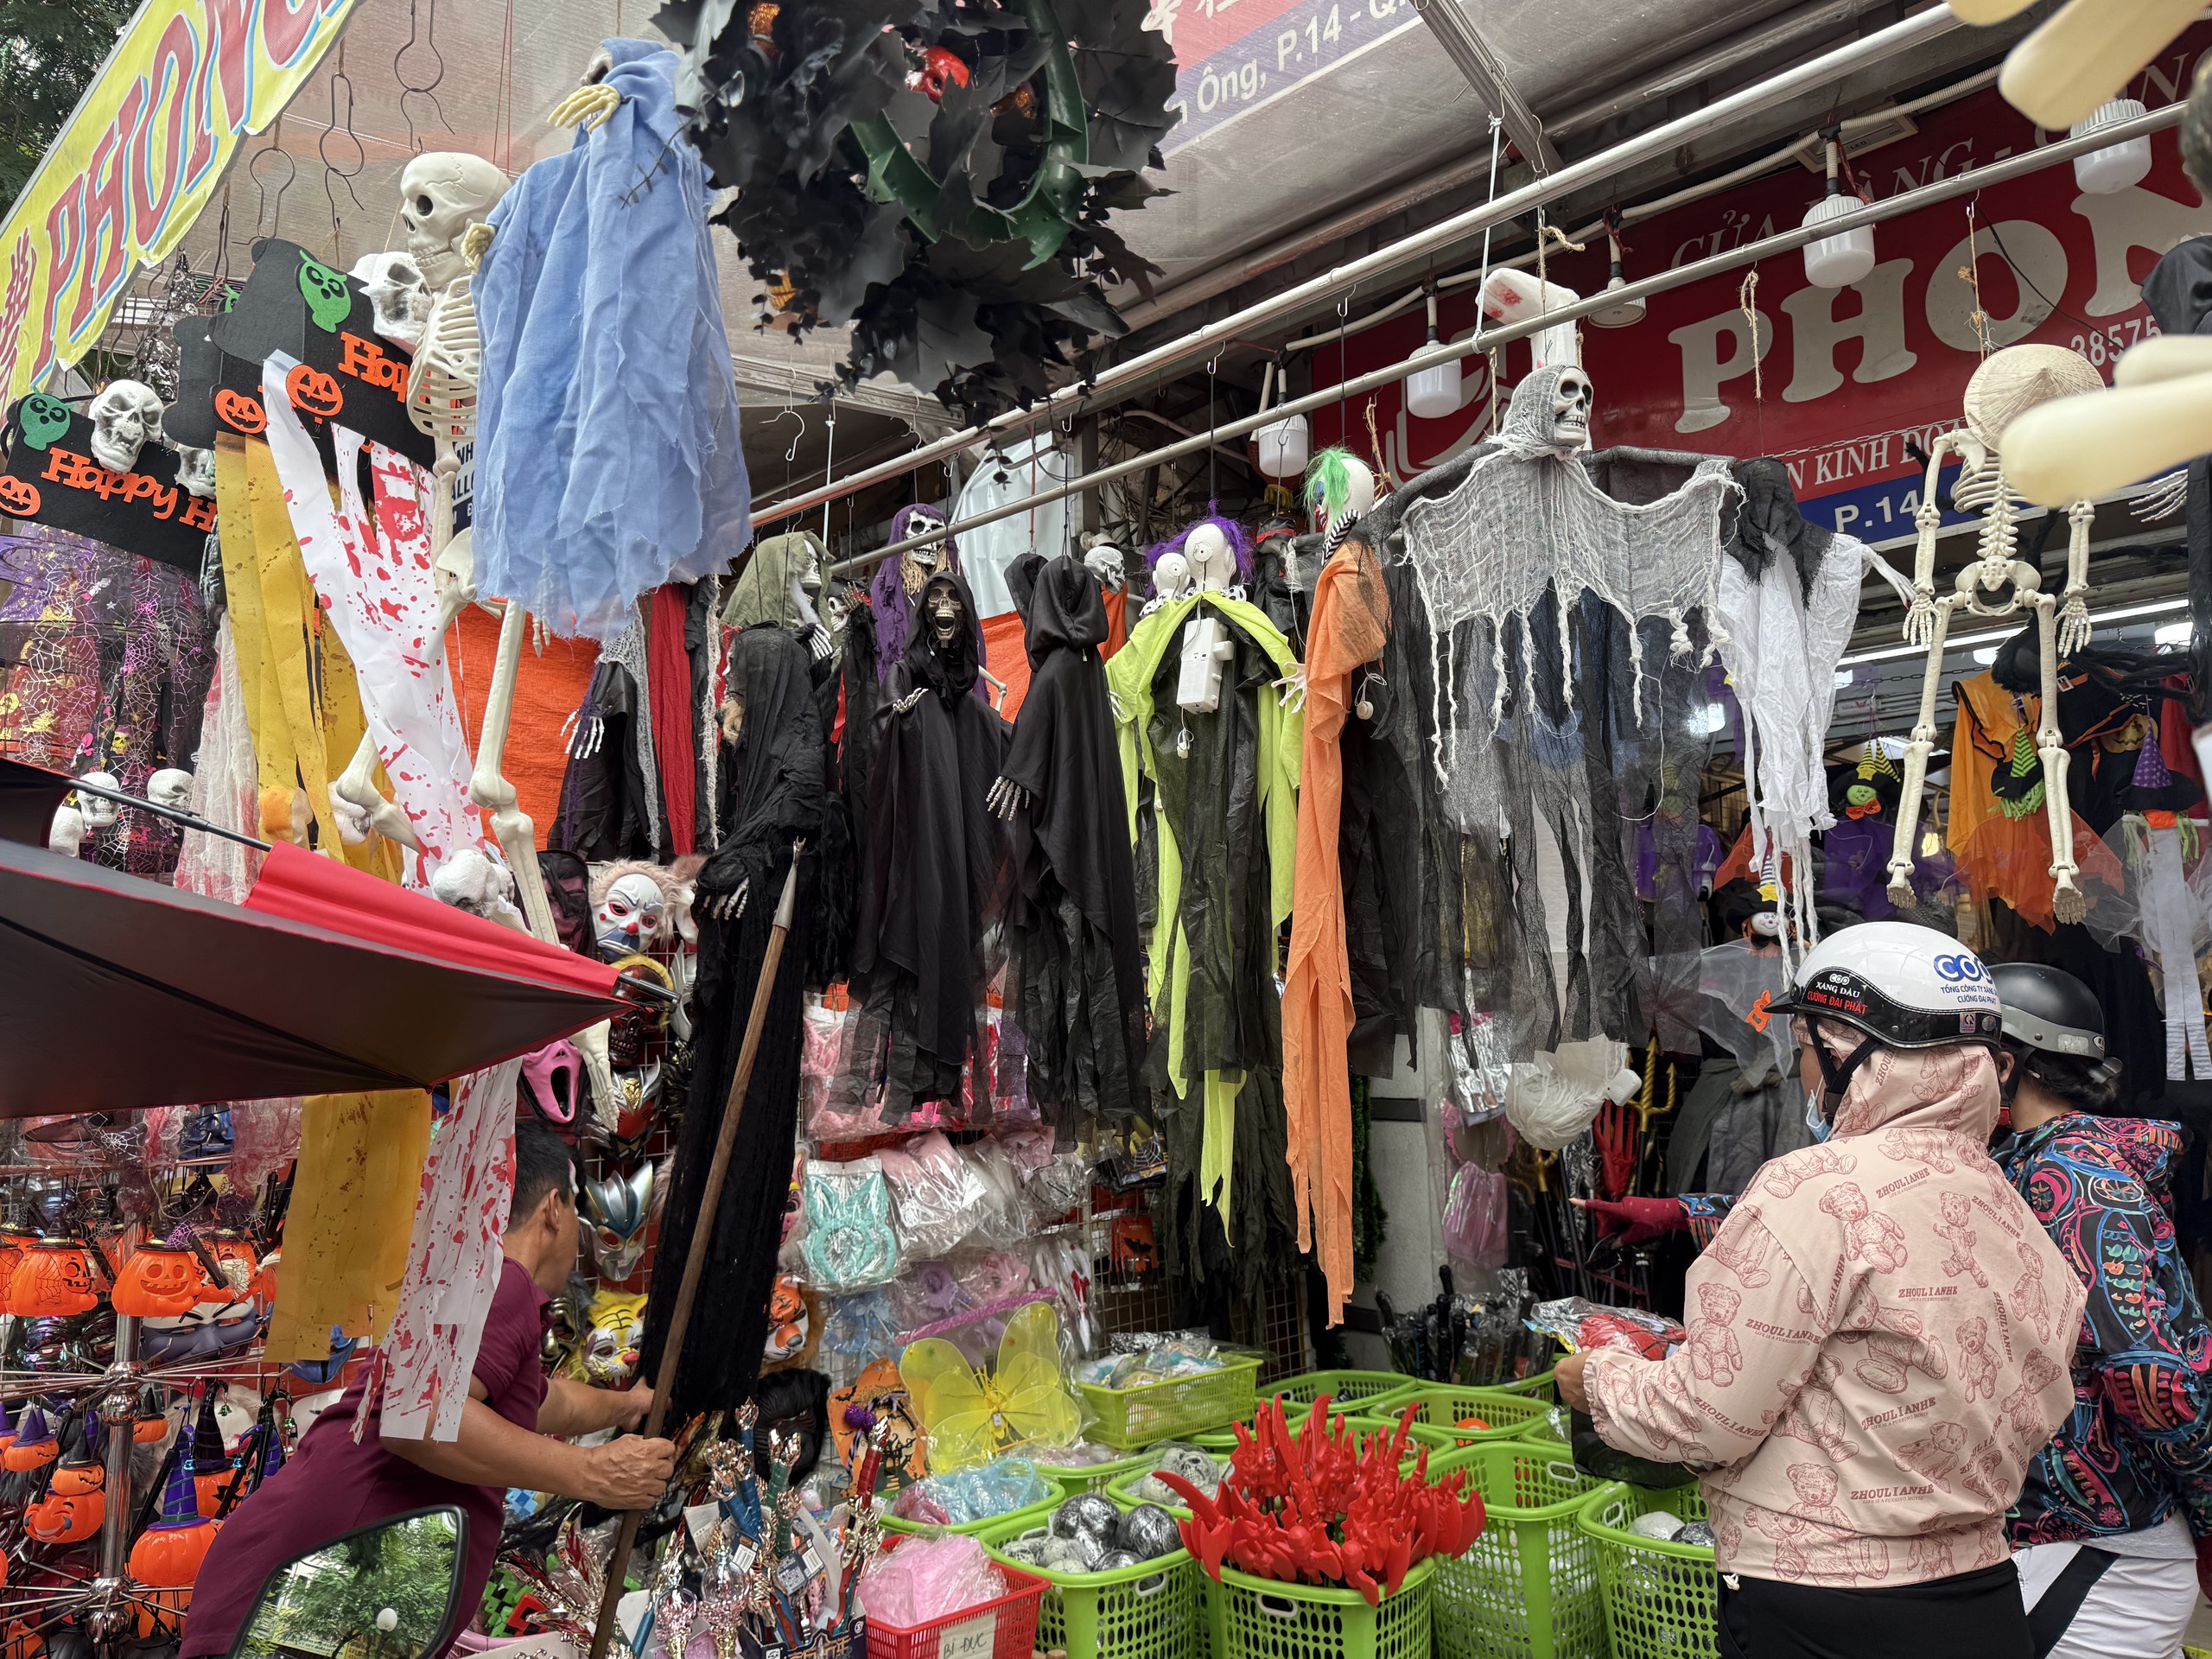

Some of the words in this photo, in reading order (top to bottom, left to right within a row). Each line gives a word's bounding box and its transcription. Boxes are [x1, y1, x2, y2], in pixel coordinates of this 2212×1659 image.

[1197, 59, 1267, 114] Ông,
[1277, 4, 1343, 72] P.14
[1815, 436, 1891, 485] KINH
[41, 447, 178, 520] Happy
[1834, 489, 1923, 533] P.14
[1844, 999, 1868, 1014] PHÁT
[1876, 1167, 1930, 1198] ZHOULIANHE
[1971, 1195, 2021, 1239] ZHOULIANHE
[1897, 1286, 1958, 1298] ZHOULIANHE
[1745, 1319, 1821, 1344] ZHOULIANHE
[1993, 1291, 2013, 1363] ZHOULIANHE
[1861, 1396, 1936, 1431] ZHOULIANHE
[1850, 1484, 1935, 1500] ZHOULIANHE
